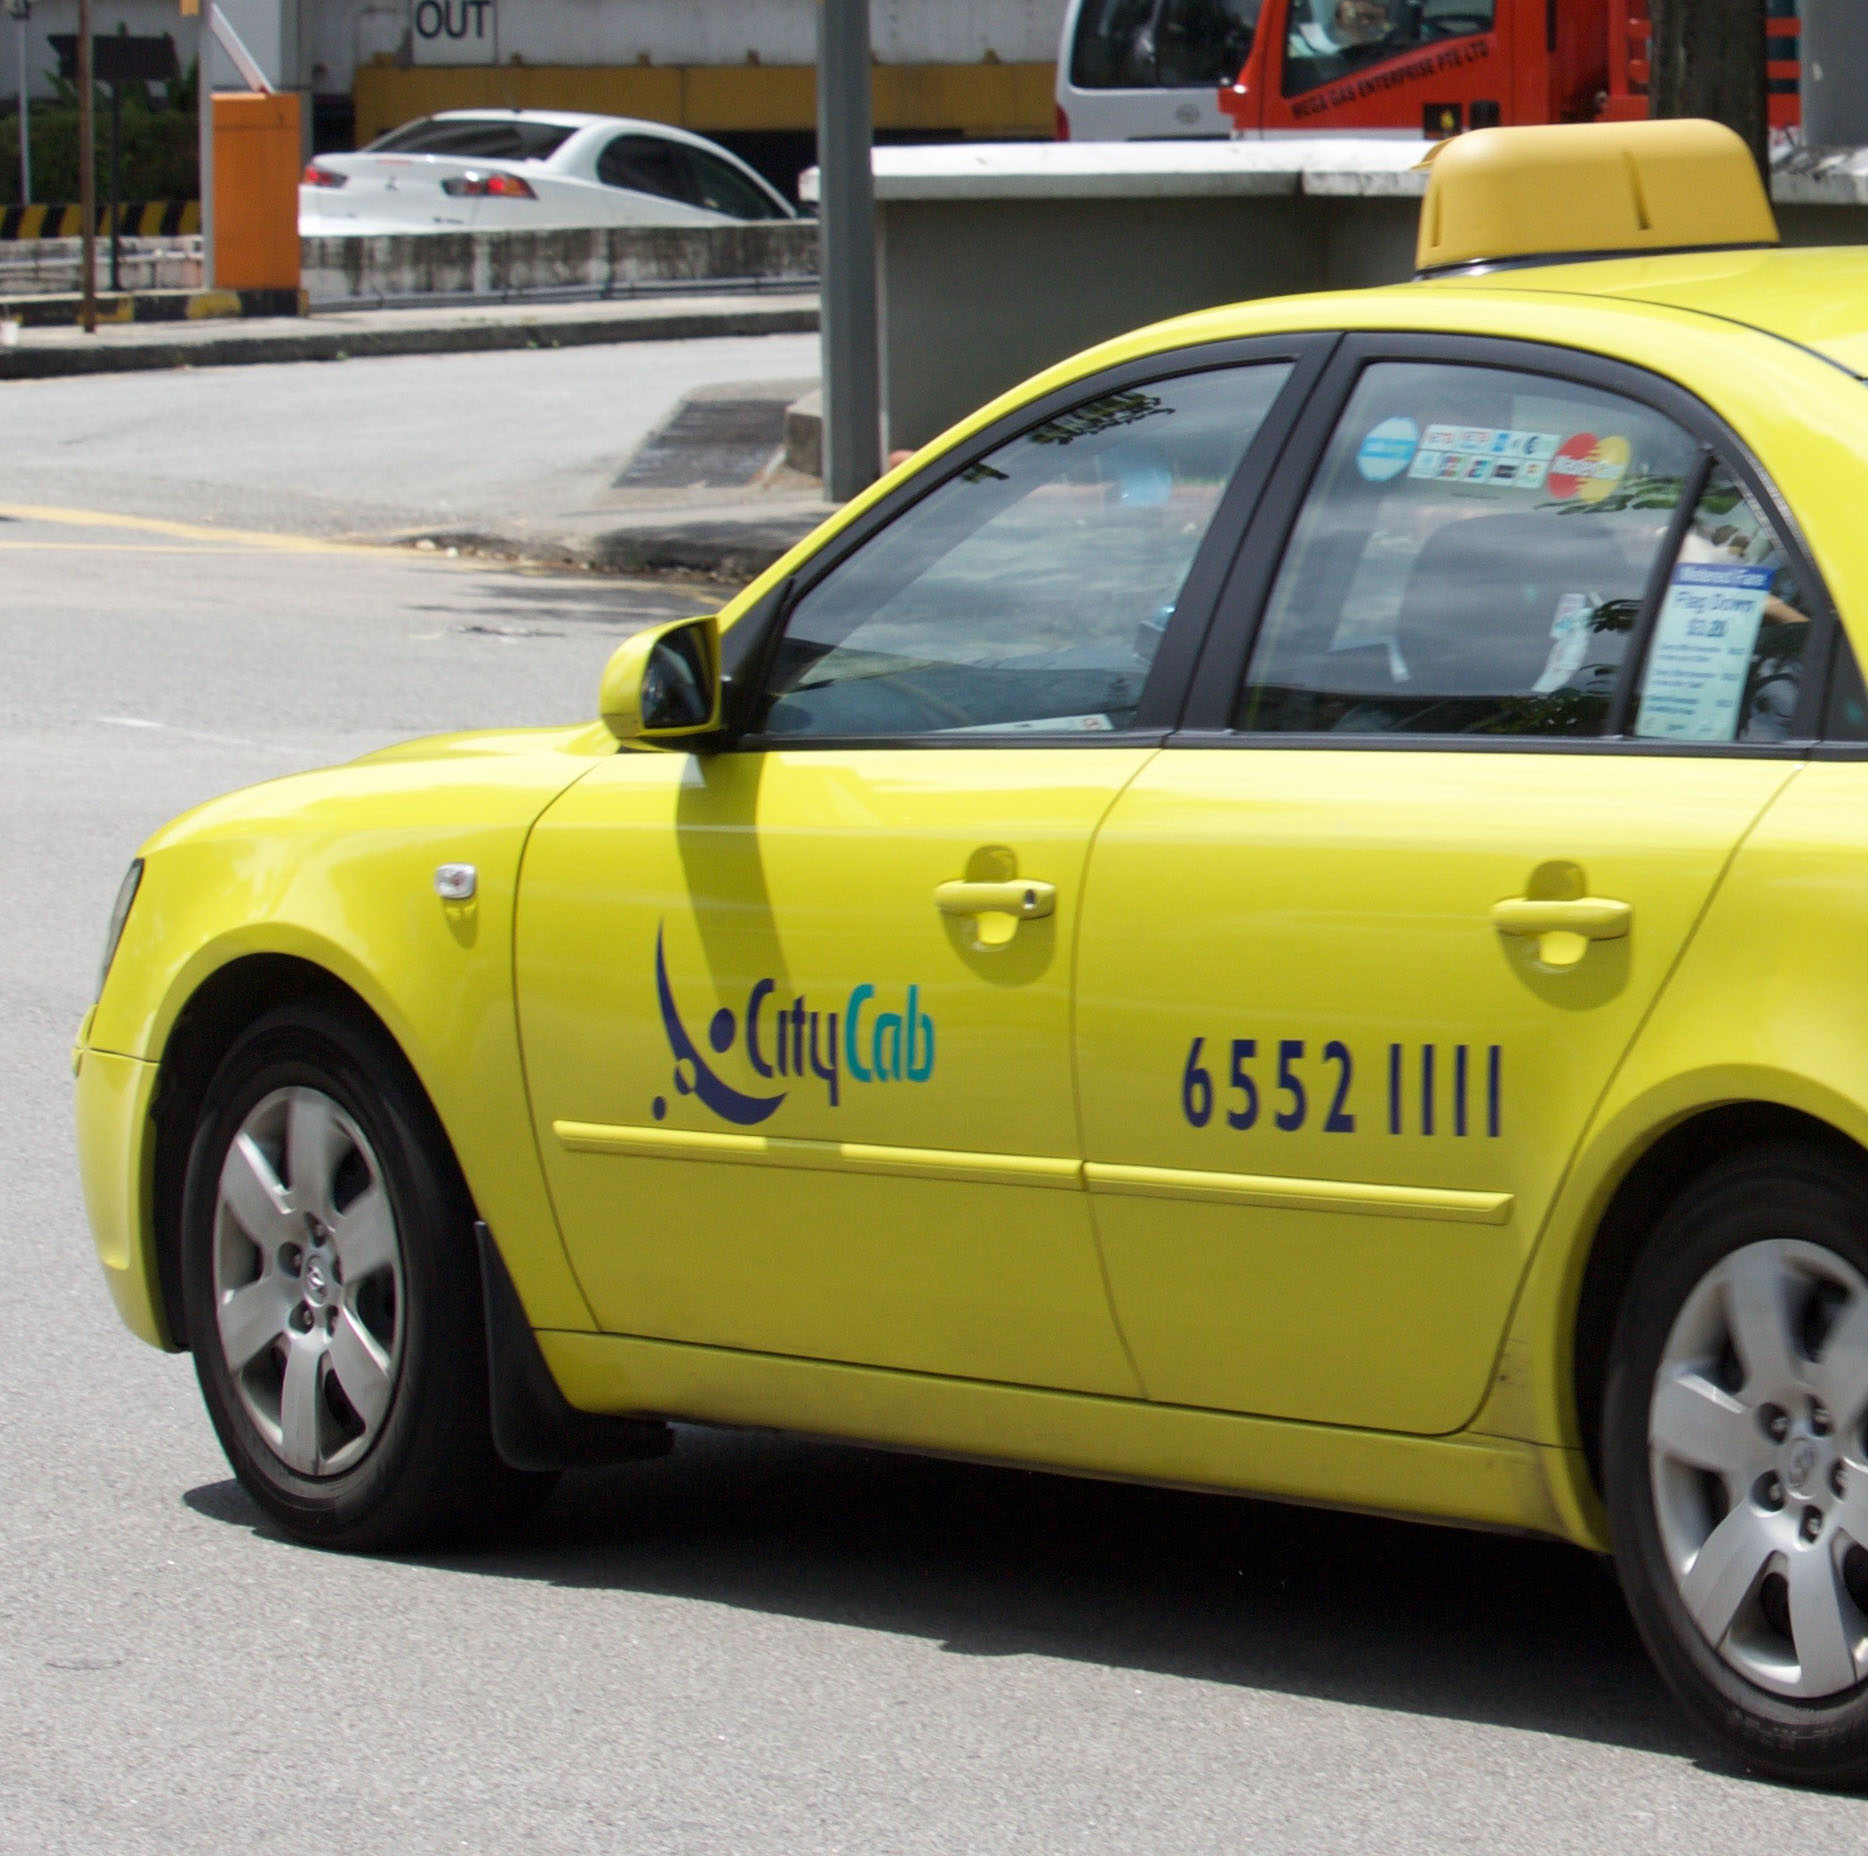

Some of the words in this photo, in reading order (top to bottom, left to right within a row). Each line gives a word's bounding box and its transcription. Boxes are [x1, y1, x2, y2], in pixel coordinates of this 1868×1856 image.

[416, 0, 490, 38] OUT
[1329, 82, 1357, 107] GAS
[1357, 57, 1437, 98] ENTERPRISE
[1436, 49, 1464, 71] PTE
[1464, 42, 1490, 63] LTD
[747, 977, 936, 1108] CityCab
[1182, 1036, 1356, 1133] 6552
[1388, 1043, 1503, 1138] 1111
